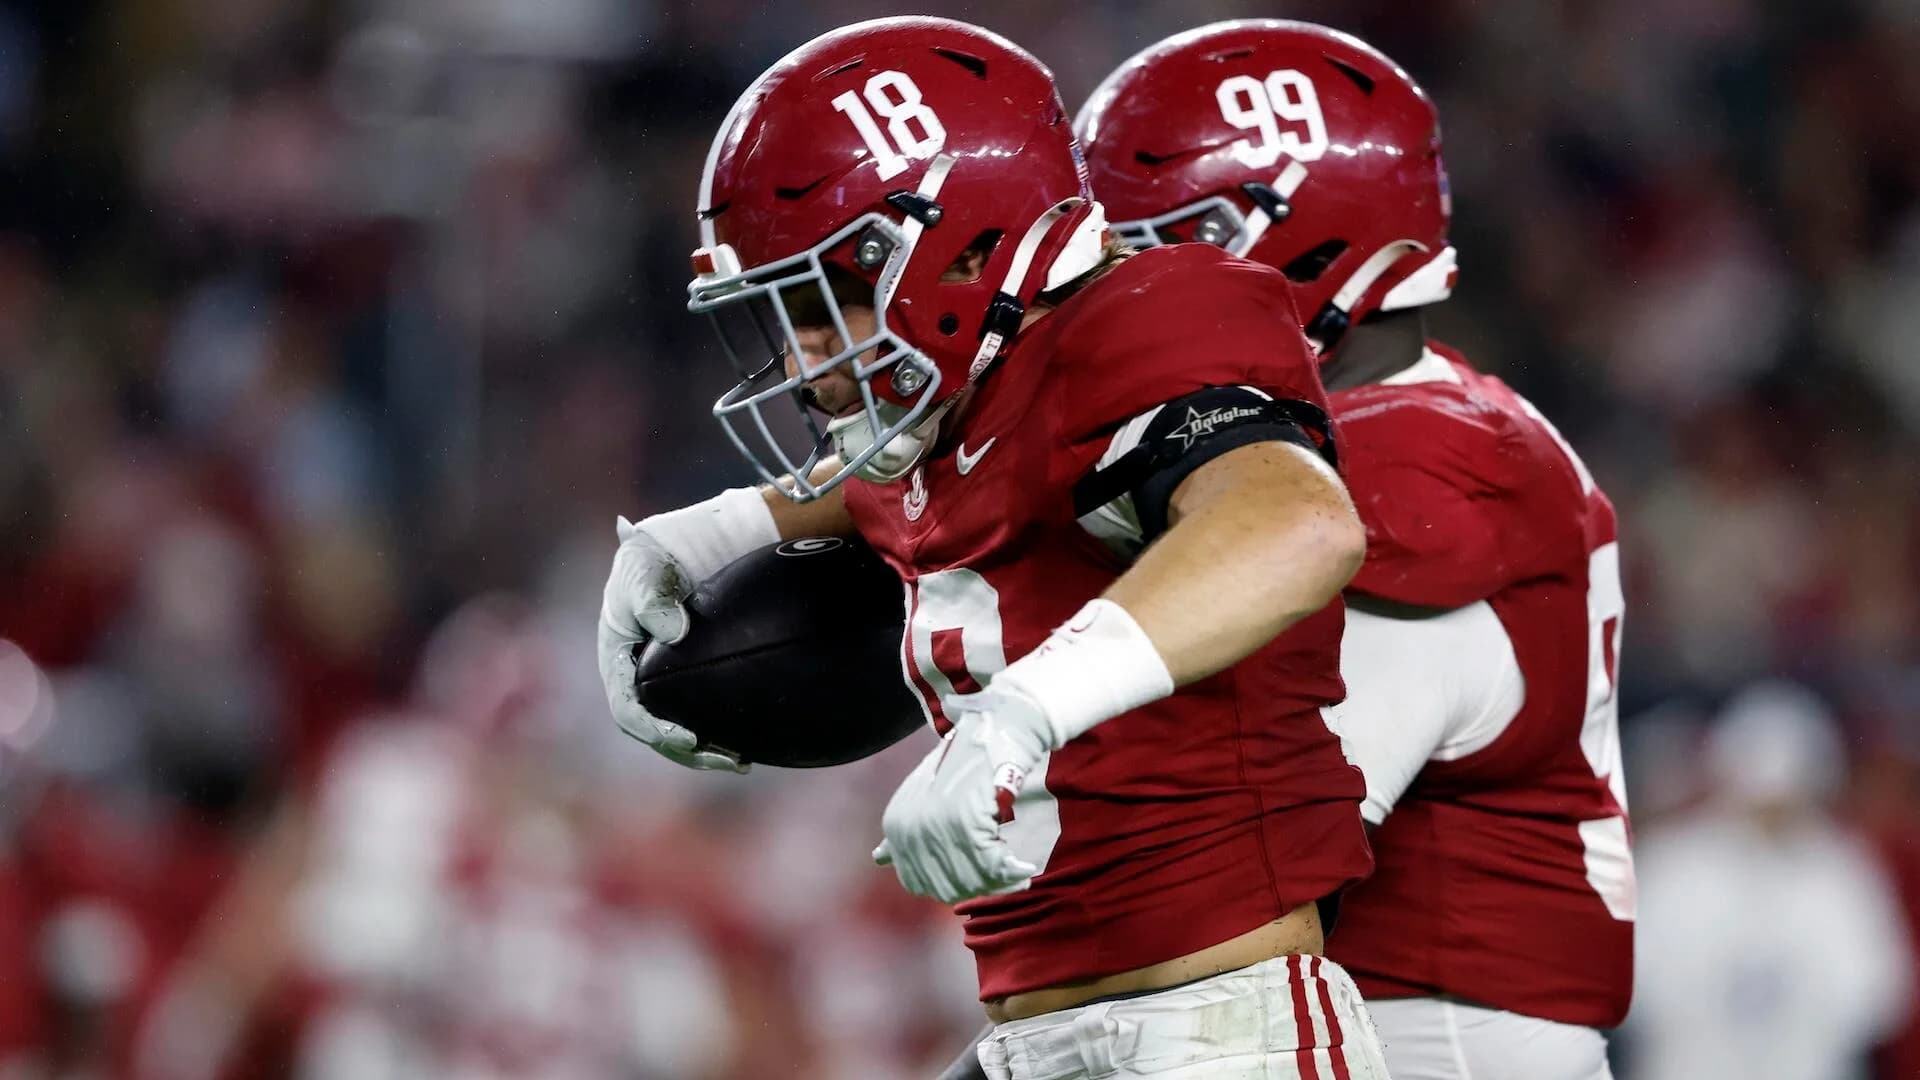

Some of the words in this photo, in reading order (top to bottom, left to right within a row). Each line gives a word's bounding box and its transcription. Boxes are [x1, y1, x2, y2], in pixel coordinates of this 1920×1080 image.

[831, 70, 947, 182] 18
[1215, 69, 1329, 170] 99
[1189, 407, 1260, 435] Douglas
